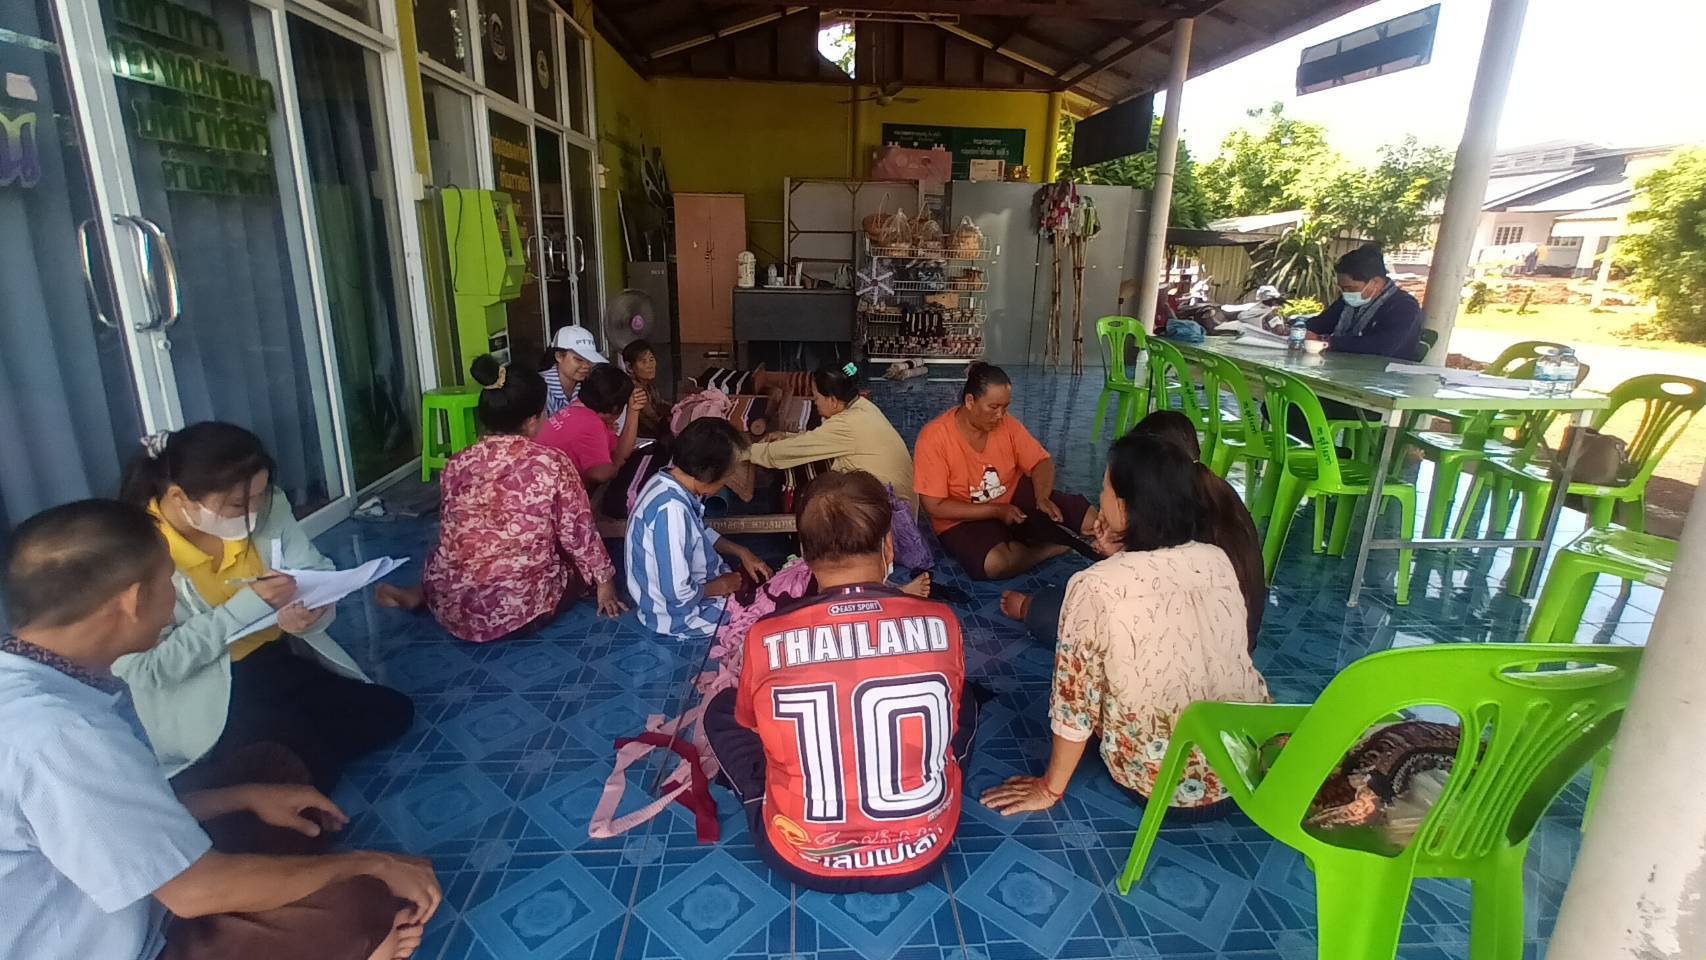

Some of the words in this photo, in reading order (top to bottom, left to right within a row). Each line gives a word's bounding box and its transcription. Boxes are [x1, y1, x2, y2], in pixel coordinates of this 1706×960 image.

[841, 604, 856, 612] EASY
[858, 603, 878, 612] SPORT
[764, 617, 948, 670] THAILAND
[772, 673, 951, 823] 10
